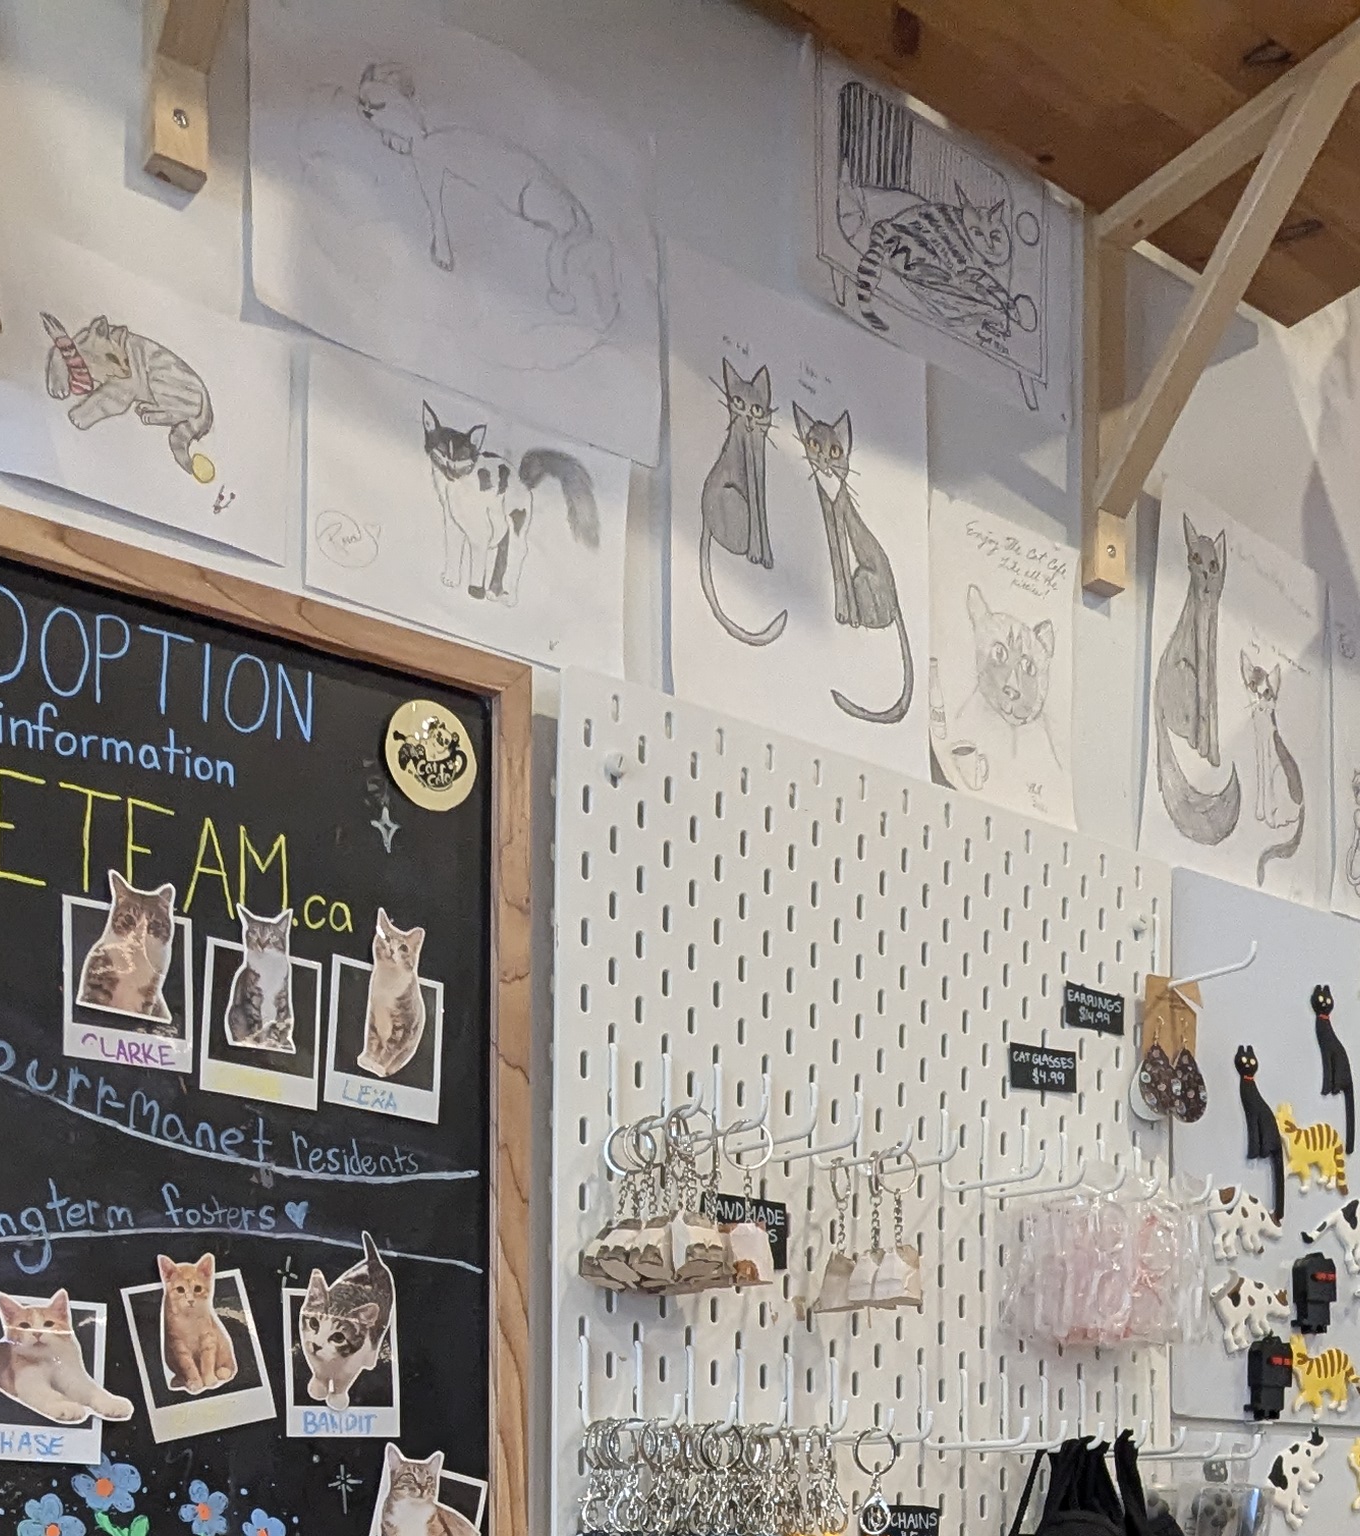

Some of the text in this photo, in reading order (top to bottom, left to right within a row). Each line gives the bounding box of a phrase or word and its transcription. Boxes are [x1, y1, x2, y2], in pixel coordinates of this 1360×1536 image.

[1066, 988, 1122, 1014] EARRINGS
[1012, 1050, 1075, 1070] CAT GLASSES
[1031, 1066, 1066, 1086] $4.99
[291, 1130, 419, 1176] residents
[161, 1182, 277, 1230] fosters
[302, 1411, 377, 1436] BANDIT
